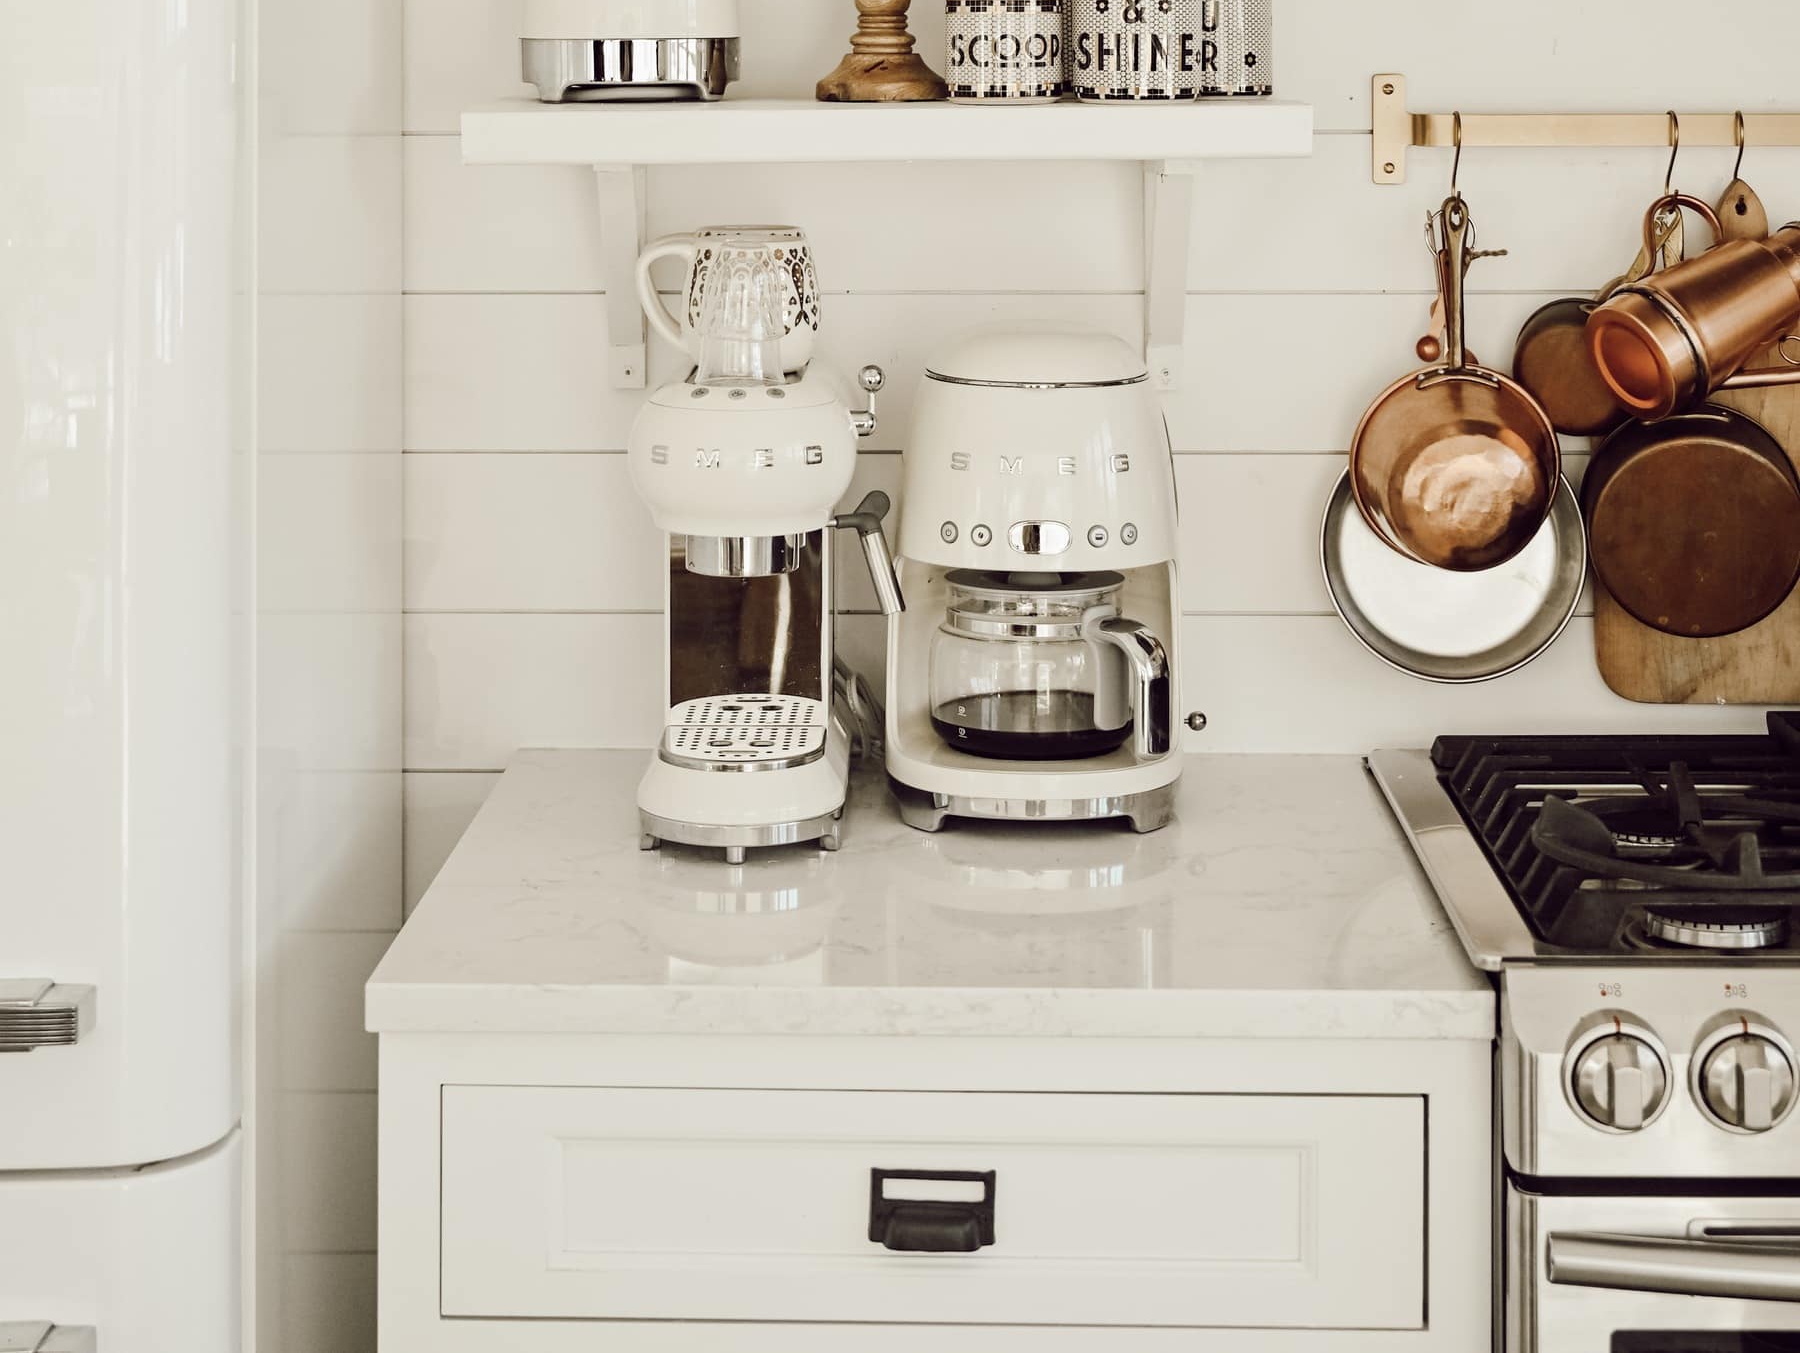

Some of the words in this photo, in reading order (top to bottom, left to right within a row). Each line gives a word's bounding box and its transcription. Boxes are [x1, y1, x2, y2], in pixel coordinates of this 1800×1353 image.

[951, 33, 1060, 68] SCOOP
[1076, 33, 1194, 72] SHINE
[650, 445, 823, 469] SMEG
[950, 452, 1130, 476] SMEG
